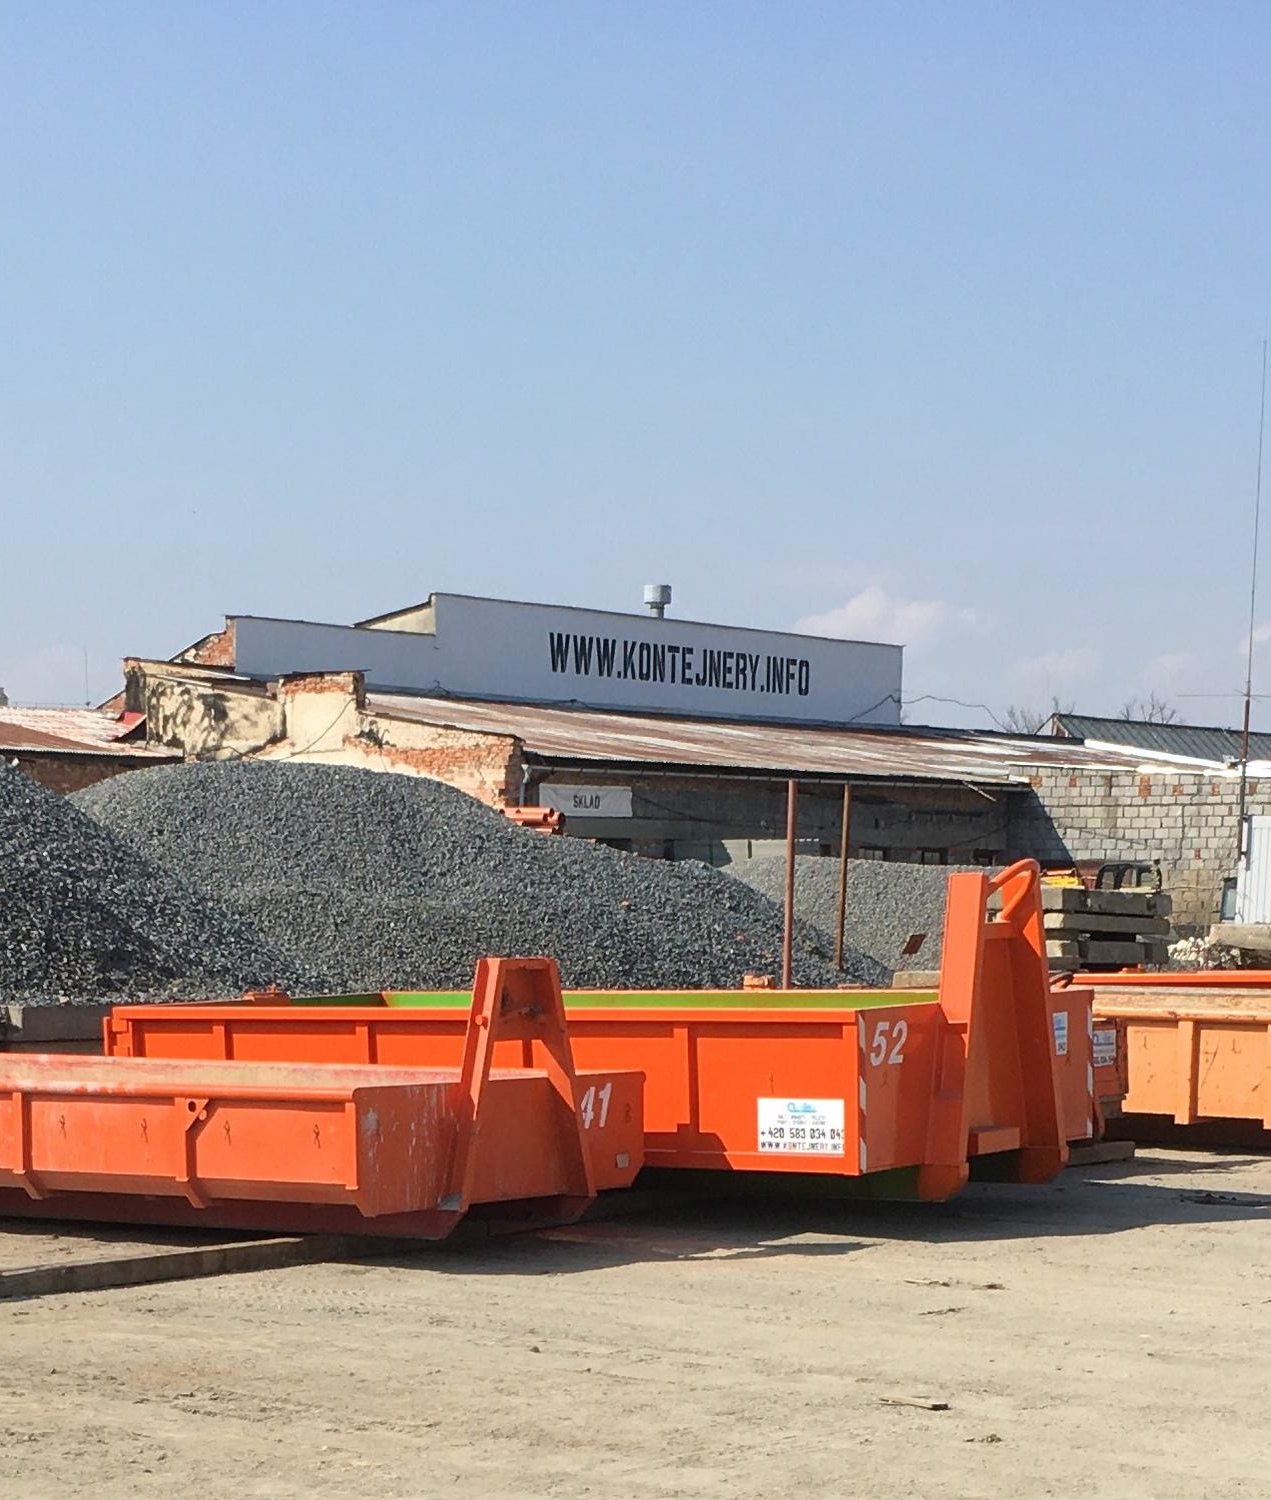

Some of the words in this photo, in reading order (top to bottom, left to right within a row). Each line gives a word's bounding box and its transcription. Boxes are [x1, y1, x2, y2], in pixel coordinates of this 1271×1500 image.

[549, 632, 810, 696] WWW.KONTEJNERY.INFO
[573, 794, 601, 809] SKLAD
[870, 1020, 908, 1067] 52
[580, 1082, 612, 1130] 41
[789, 1127, 806, 1139] 583
[809, 1128, 826, 1140] 034
